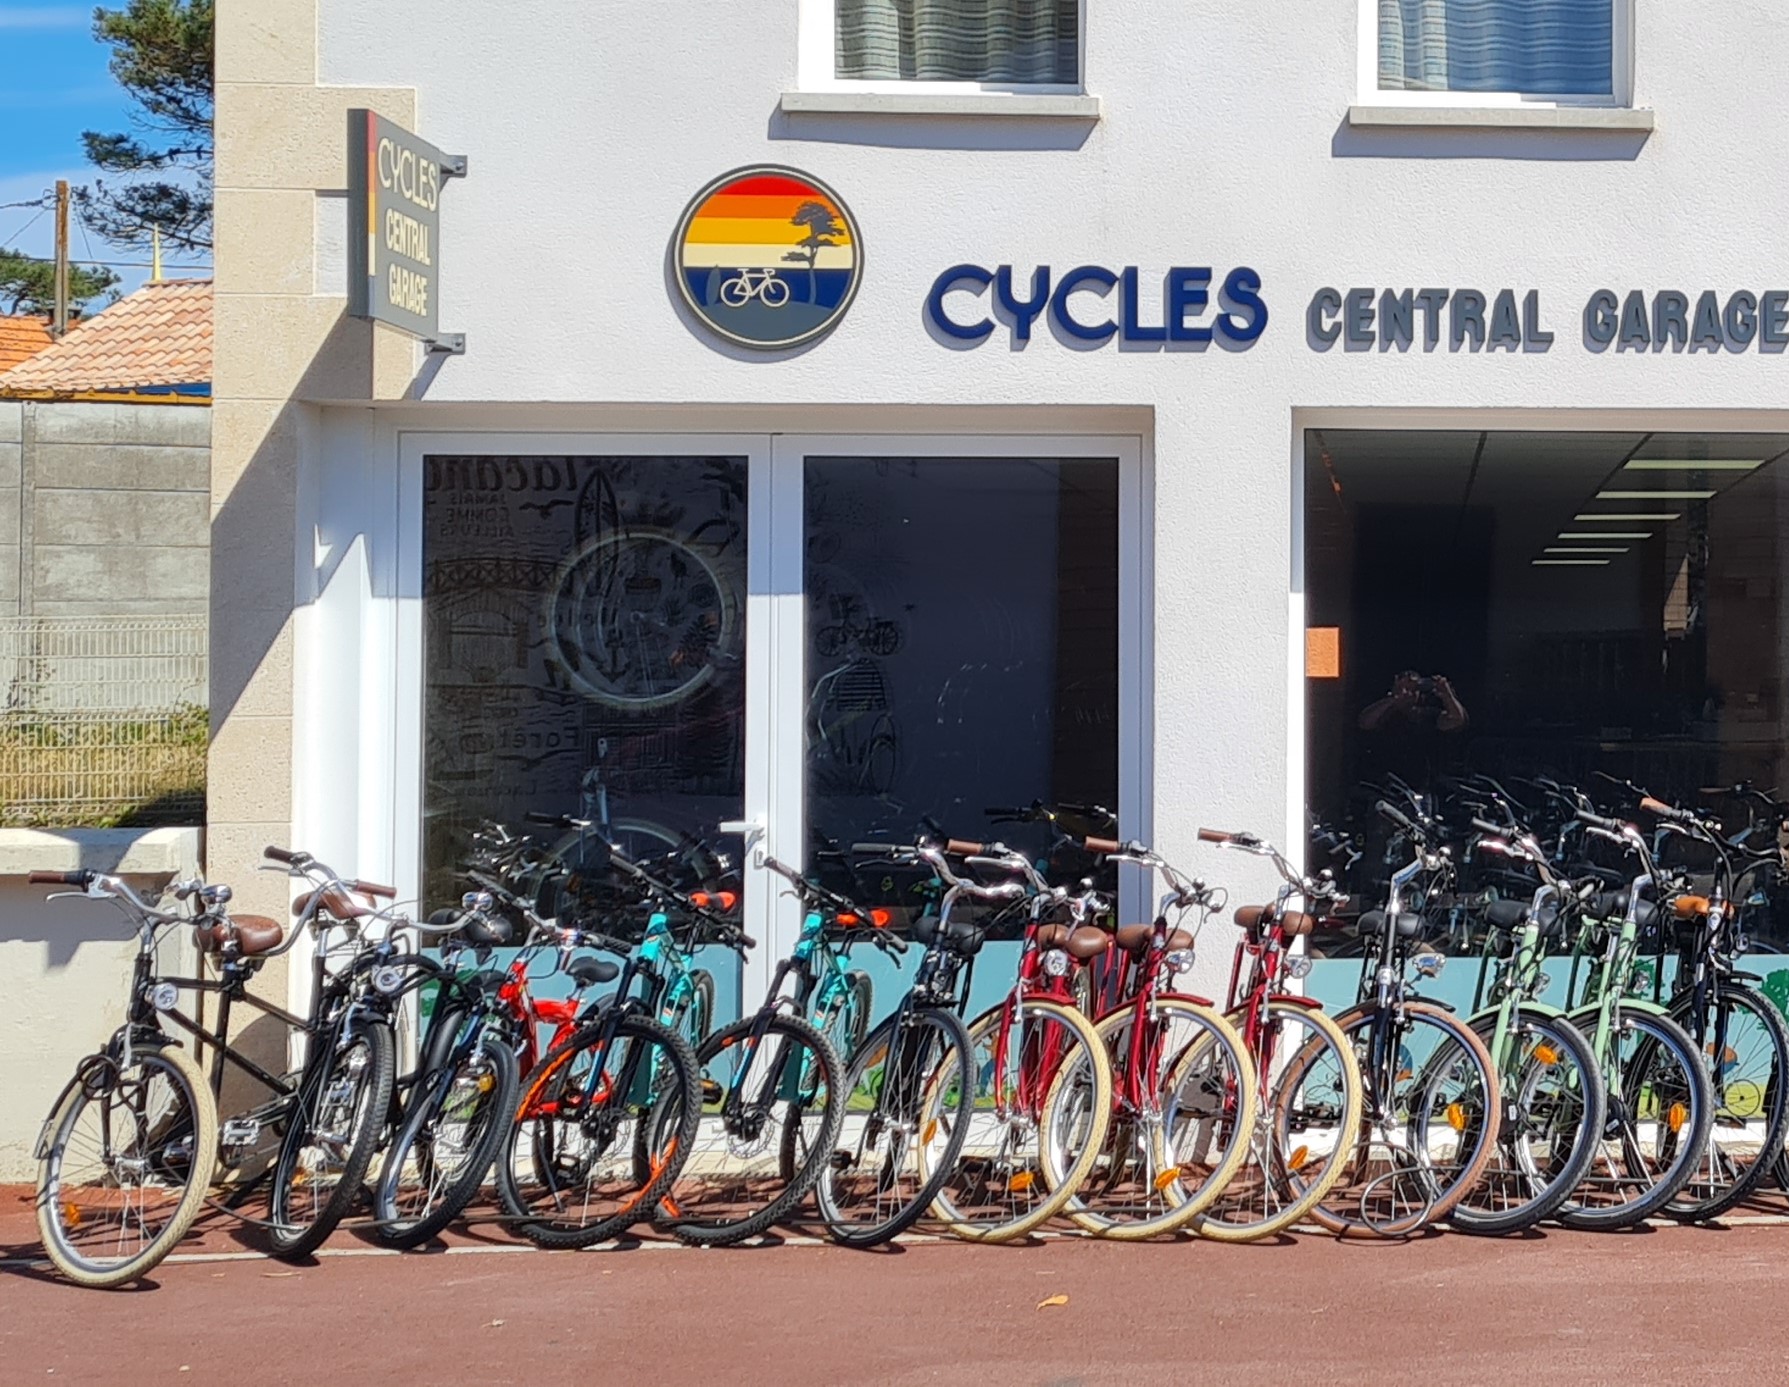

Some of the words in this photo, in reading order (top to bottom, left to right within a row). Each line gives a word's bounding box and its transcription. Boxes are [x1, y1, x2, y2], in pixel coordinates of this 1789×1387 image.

[378, 138, 437, 212] CYCLES
[386, 208, 431, 266] CENTRAL
[388, 263, 428, 316] GARAGE
[922, 263, 1268, 353] CYCLES
[1306, 287, 1554, 353] CENTRAL
[1583, 289, 1789, 355] GARAGE
